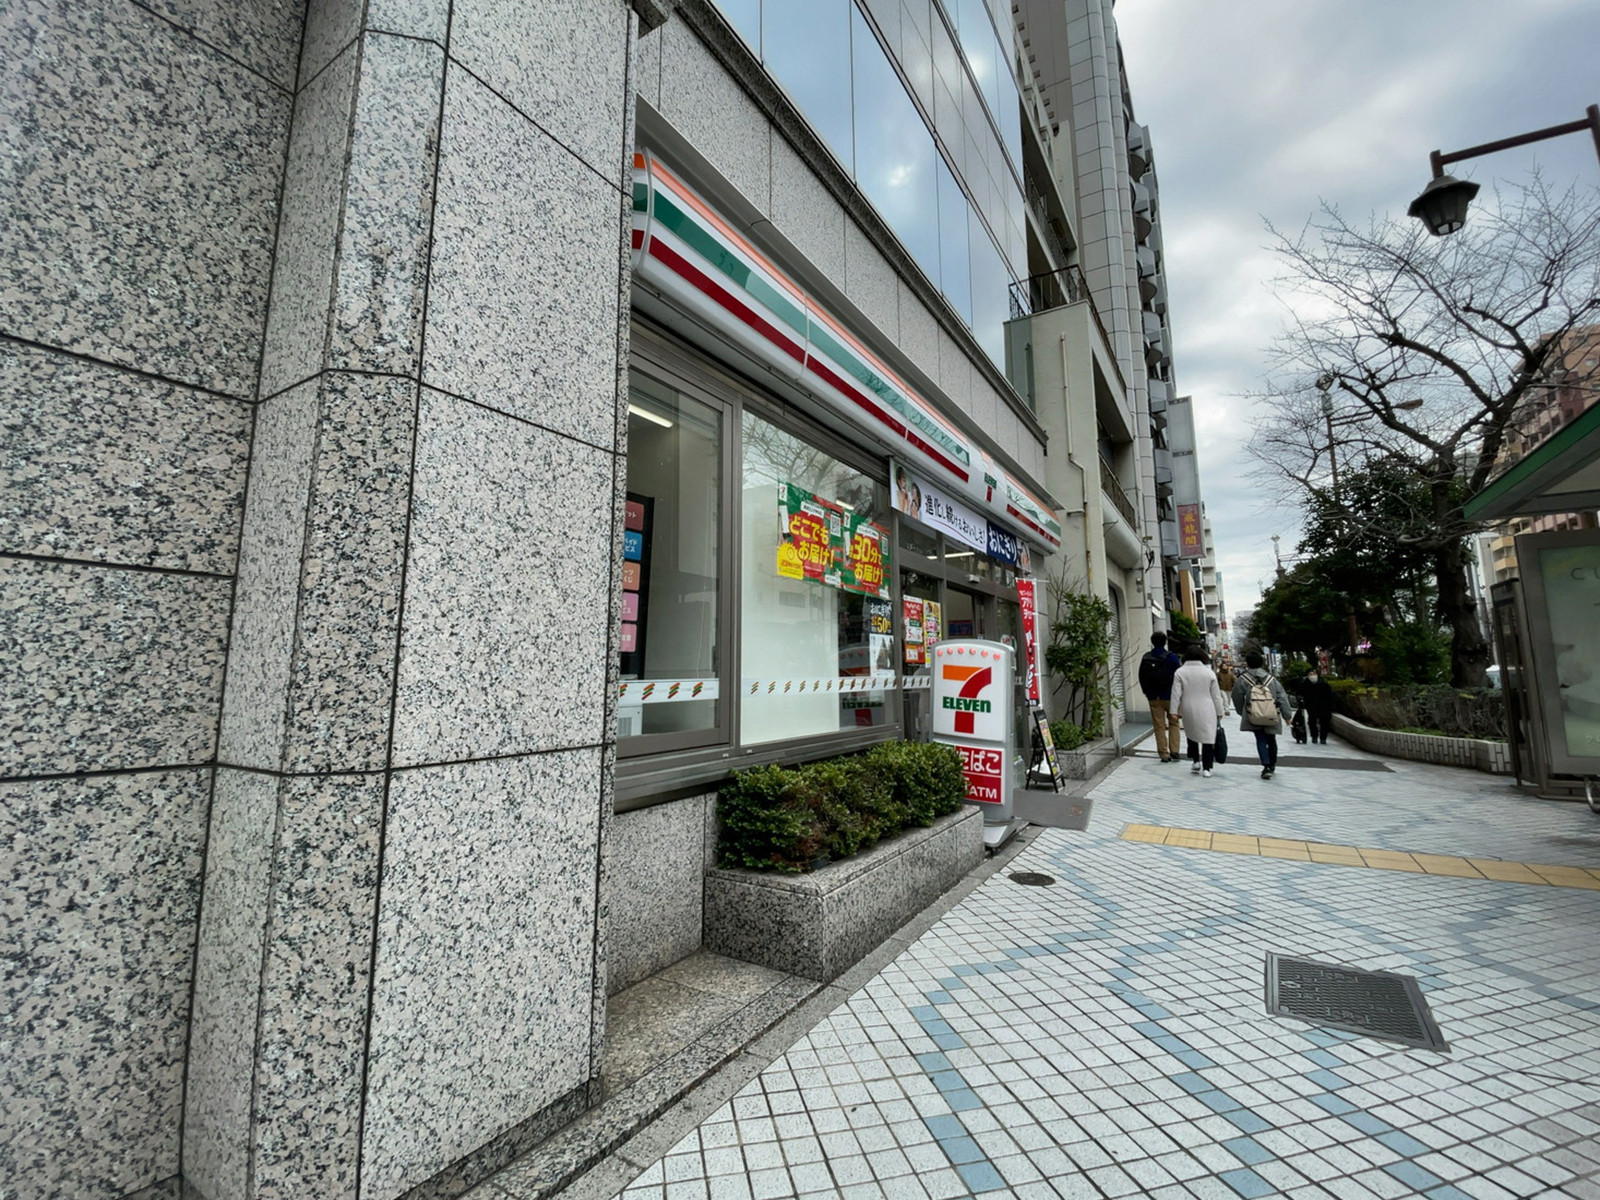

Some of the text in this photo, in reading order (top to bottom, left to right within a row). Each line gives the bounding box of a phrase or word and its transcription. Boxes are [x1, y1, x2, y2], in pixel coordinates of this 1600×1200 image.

[789, 515, 829, 545] どこでも
[988, 525, 1017, 563] おにぎり
[798, 540, 835, 569] お届け!
[854, 562, 883, 585] お届け!
